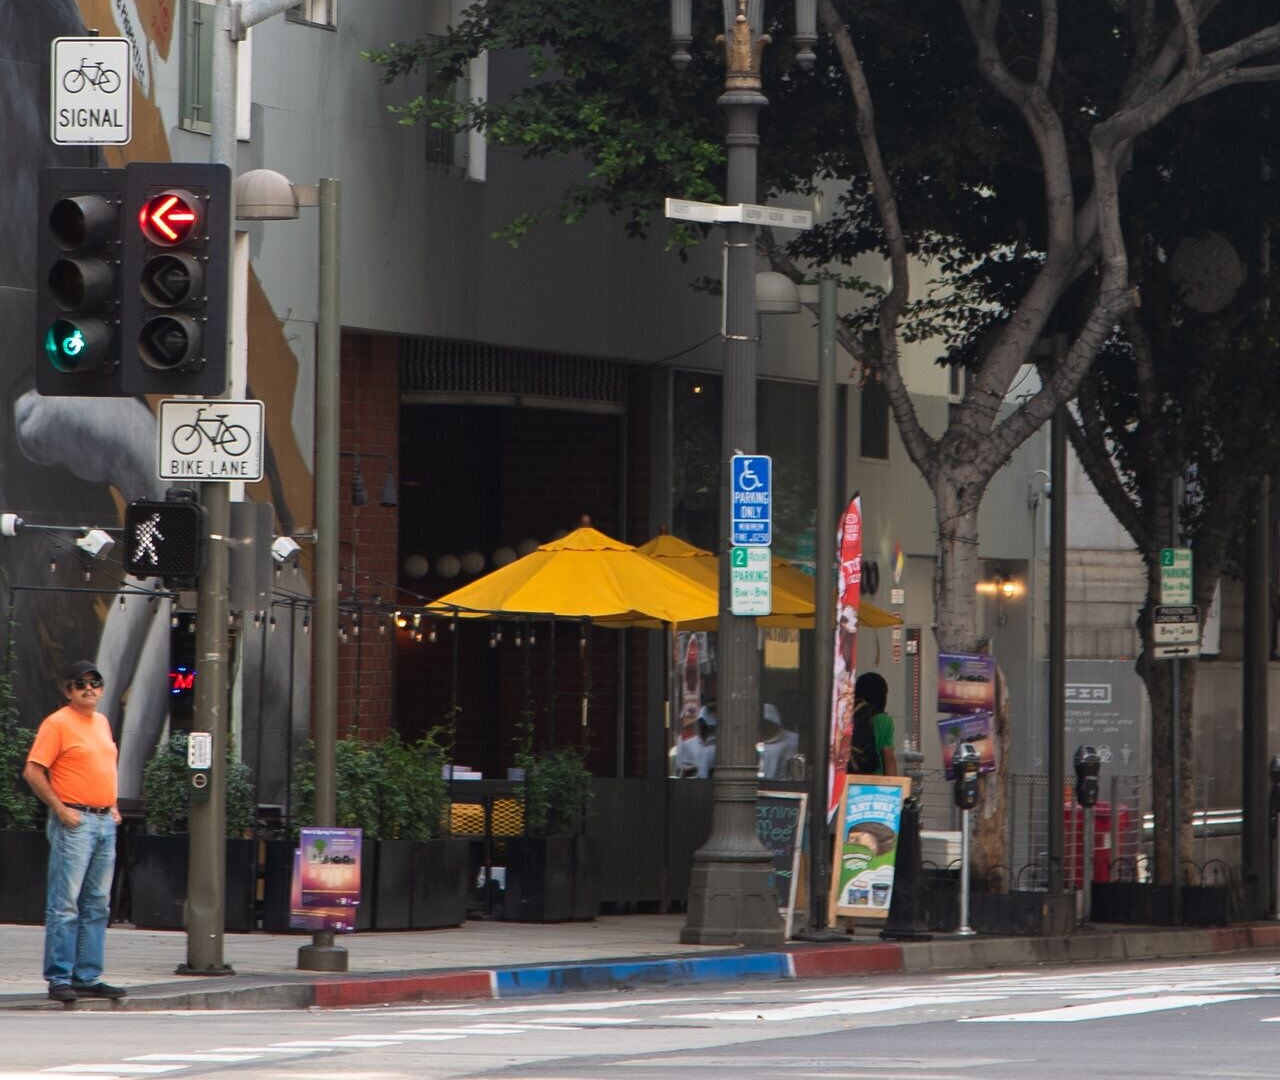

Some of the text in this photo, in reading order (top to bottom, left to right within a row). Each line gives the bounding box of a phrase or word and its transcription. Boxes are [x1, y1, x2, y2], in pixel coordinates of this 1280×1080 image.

[59, 108, 124, 127] SIGNAL
[171, 460, 248, 476] BIKE LANE
[734, 492, 768, 504] PARKING
[741, 505, 762, 519] ONLY
[736, 549, 745, 565] 2
[733, 570, 769, 583] PARKING
